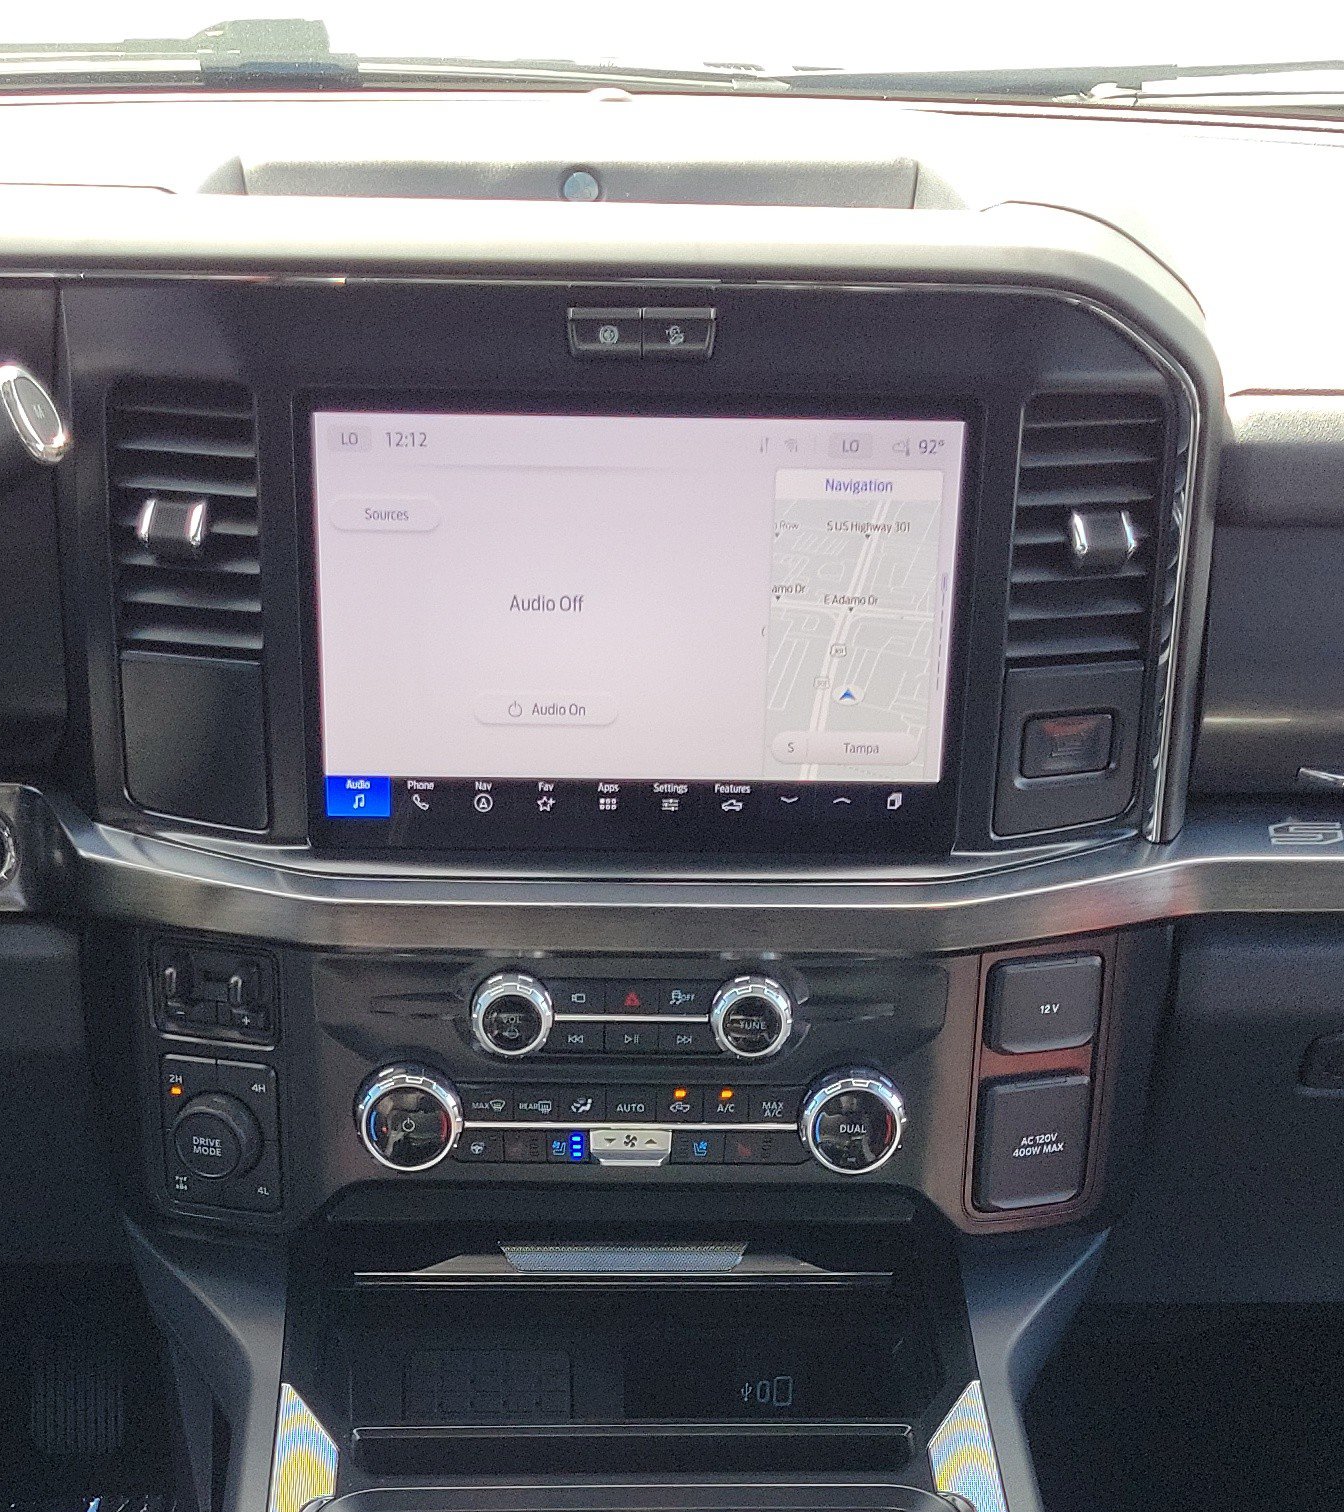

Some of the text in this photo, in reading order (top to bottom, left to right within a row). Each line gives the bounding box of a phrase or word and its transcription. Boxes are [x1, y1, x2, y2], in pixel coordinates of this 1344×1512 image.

[340, 432, 359, 446] LO
[384, 431, 428, 447] 12:12
[841, 439, 860, 453] LO
[917, 438, 946, 455] 92°
[824, 478, 894, 494] Navigation
[364, 507, 410, 522] Sources
[850, 520, 893, 534] Highway
[894, 520, 911, 533] 301
[794, 583, 807, 594] Dr
[509, 594, 584, 612] Audio Off
[831, 594, 866, 605] Adamo
[531, 702, 586, 717] Audio On
[787, 741, 795, 753] S
[843, 742, 880, 756] Tampa
[345, 778, 371, 790] Audio
[407, 780, 435, 791] Phone
[474, 781, 493, 792] Nav
[537, 781, 555, 793] Fav
[597, 782, 620, 795] Apps
[653, 783, 689, 795] Settings
[714, 783, 751, 795] Features
[739, 1020, 767, 1030] TUNE
[169, 1074, 183, 1084] 2H
[251, 1083, 266, 1094] 4H
[471, 1102, 490, 1110] MAX
[616, 1103, 645, 1113] AUTO
[716, 1103, 735, 1113] A/C
[762, 1101, 784, 1110] MAX
[764, 1109, 782, 1118] A/C
[839, 1124, 867, 1134] DUAL
[192, 1135, 222, 1148] DRIVE
[1021, 1132, 1058, 1146] AC 120V
[192, 1145, 222, 1157] MODE
[1012, 1142, 1065, 1158] 400W MAX
[257, 1186, 270, 1196] 4L
